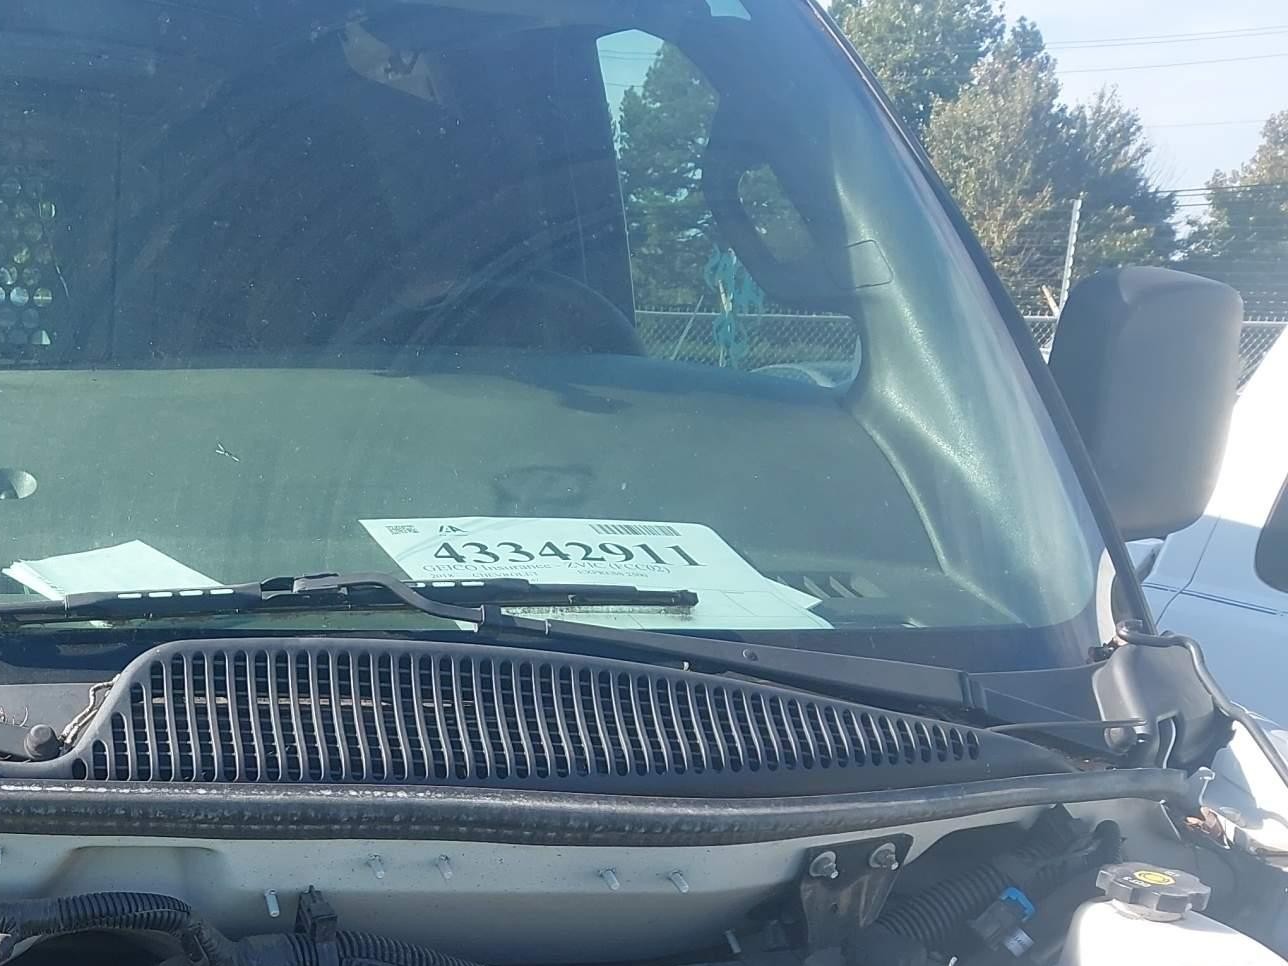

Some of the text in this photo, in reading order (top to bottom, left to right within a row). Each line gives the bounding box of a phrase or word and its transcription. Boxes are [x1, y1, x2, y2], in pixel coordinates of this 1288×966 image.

[434, 541, 708, 567] 43342911
[423, 563, 478, 572] GEICO
[481, 563, 552, 572] Insurance
